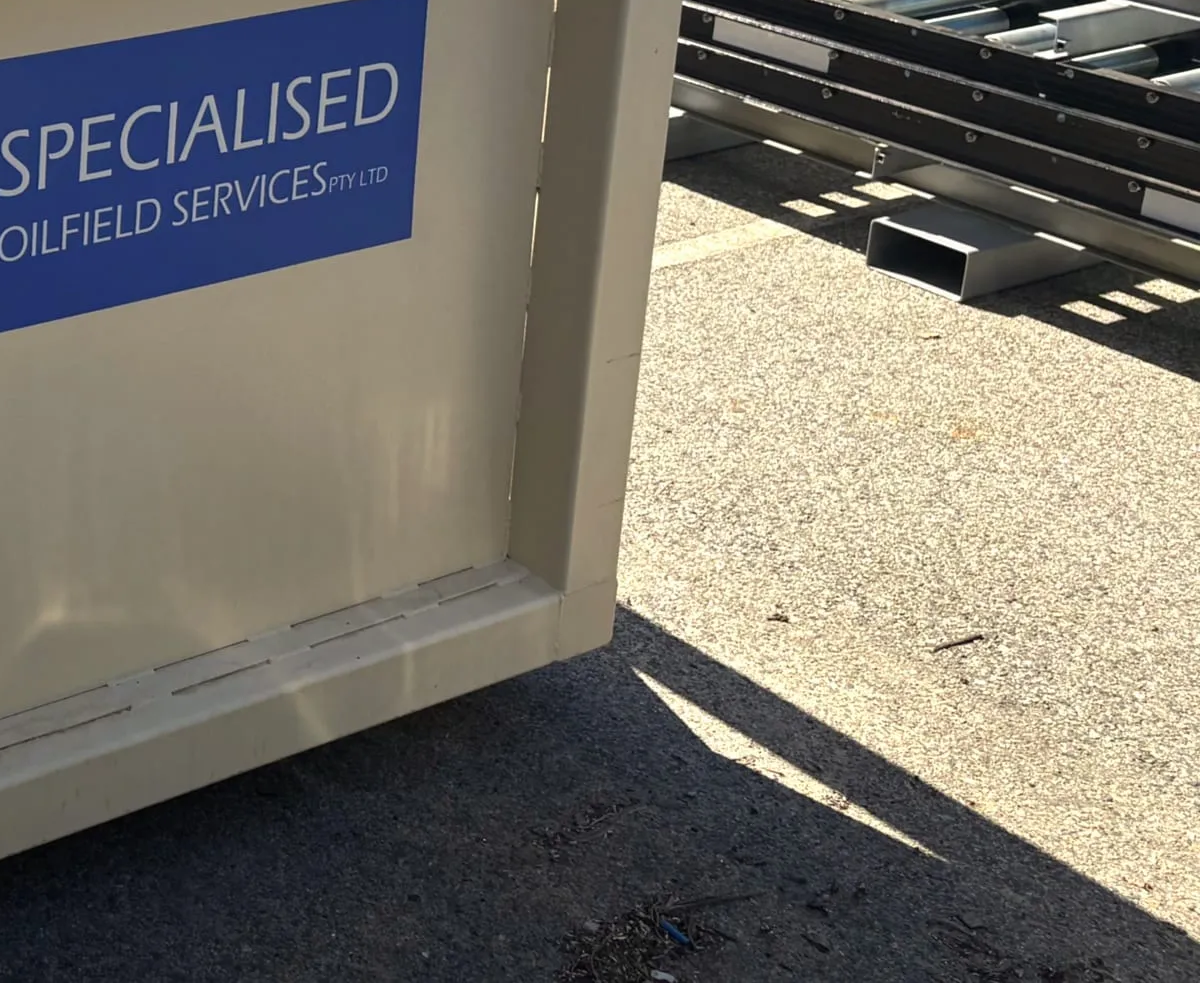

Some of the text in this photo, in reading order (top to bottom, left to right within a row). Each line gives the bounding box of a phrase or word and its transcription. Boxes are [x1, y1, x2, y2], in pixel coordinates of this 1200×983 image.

[171, 161, 328, 227] SERVICES
[328, 172, 357, 193] PTY
[359, 165, 389, 187] LTD
